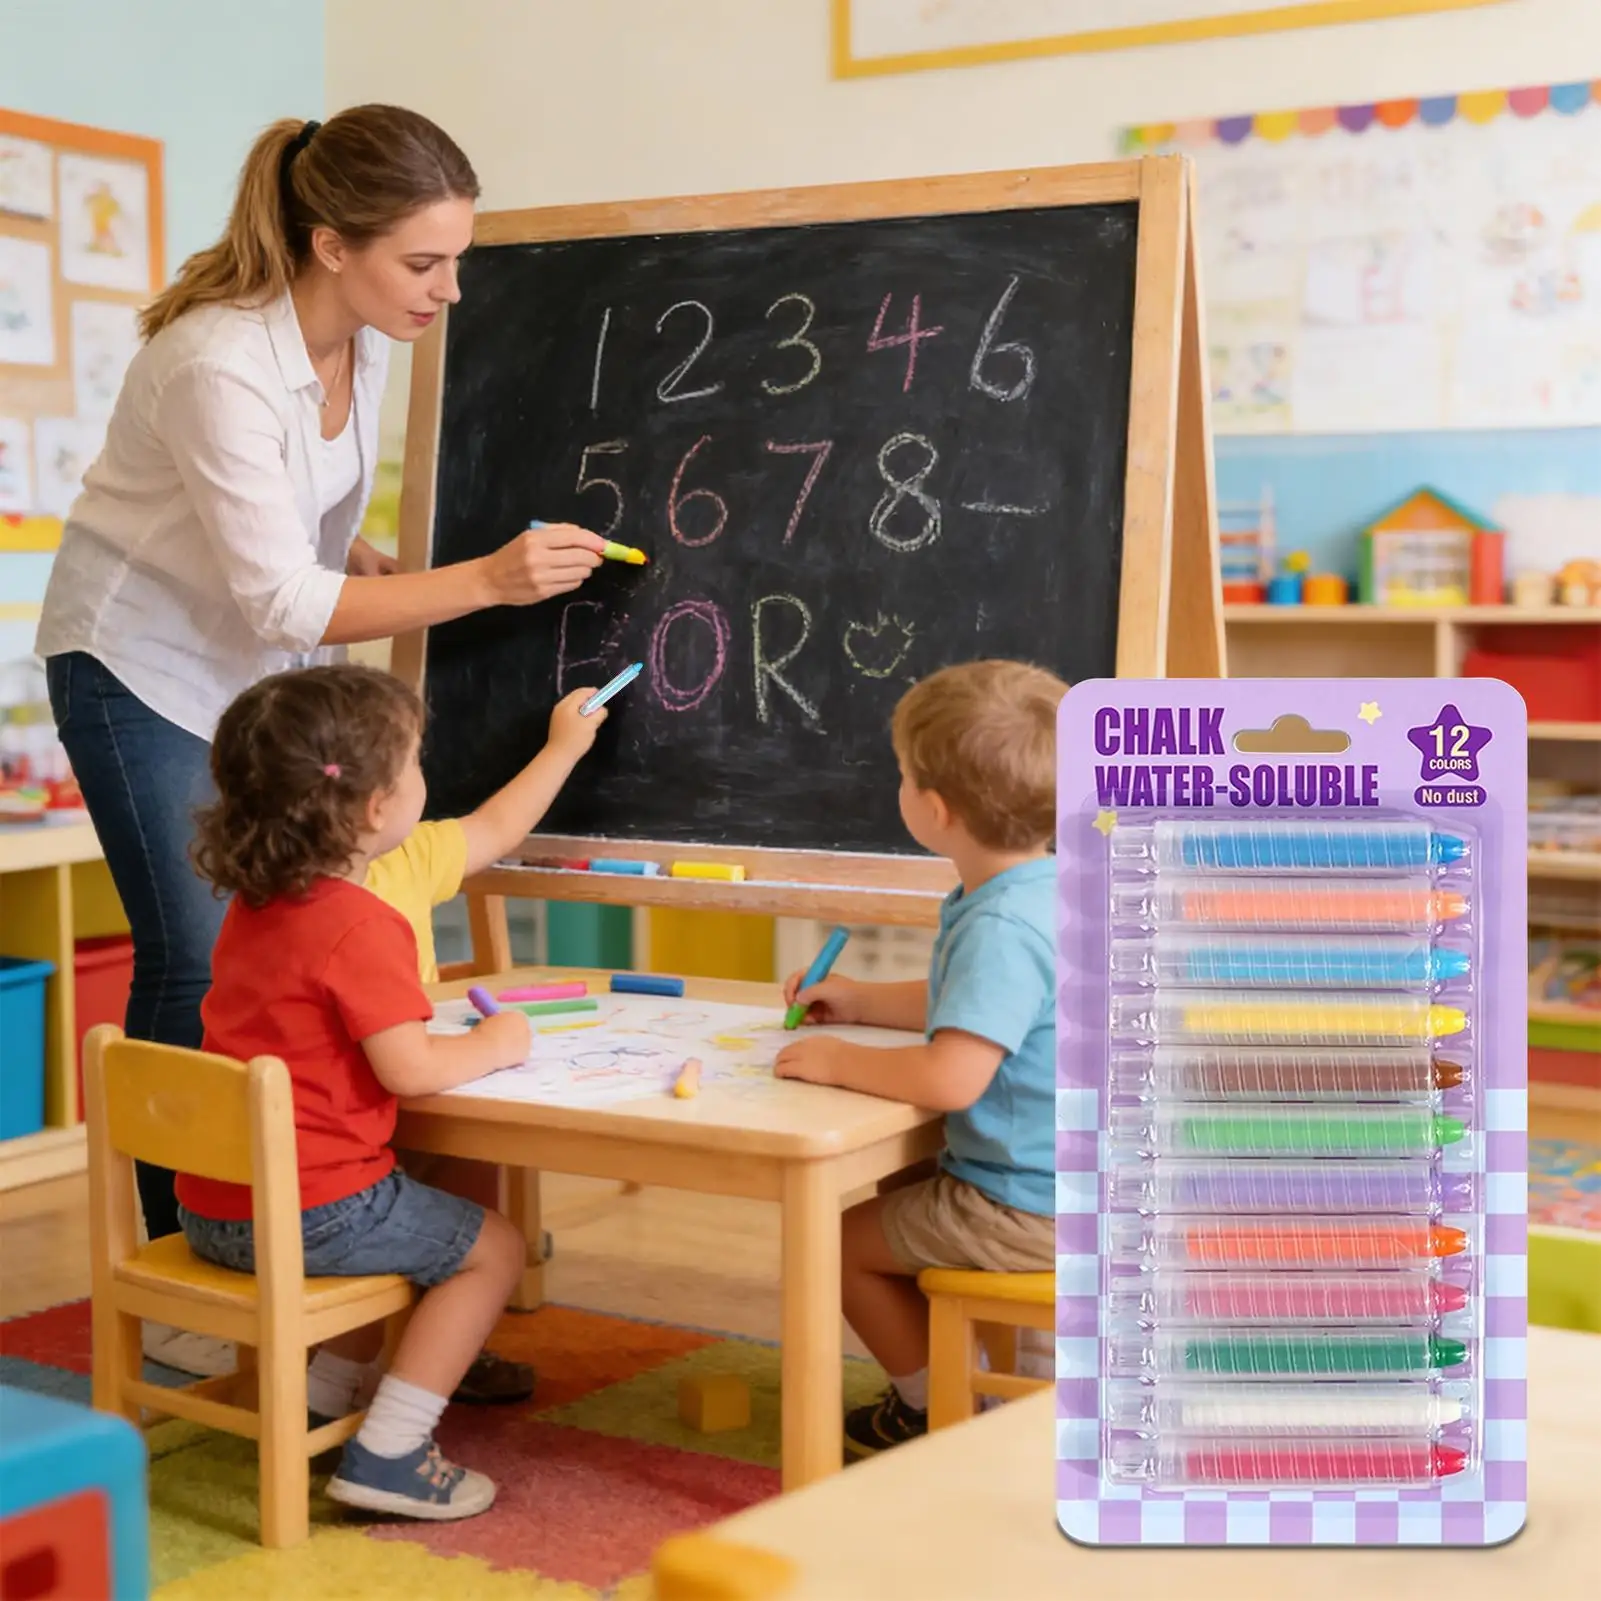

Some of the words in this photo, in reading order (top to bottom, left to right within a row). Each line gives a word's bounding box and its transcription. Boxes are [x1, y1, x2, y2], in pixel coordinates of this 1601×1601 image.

[590, 306, 611, 410] 1
[655, 300, 724, 403] 2
[760, 293, 822, 395] 3
[866, 293, 944, 392] 4
[969, 274, 1036, 402] 6
[575, 439, 628, 536] 5
[668, 434, 728, 547] 6
[765, 439, 833, 545] 7
[869, 431, 941, 552] 8
[1093, 706, 1225, 756] CHALK
[1428, 724, 1470, 757] 12
[1094, 764, 1379, 807] WATER-SOLUBLE
[1429, 758, 1472, 770] COLORS
[1422, 788, 1442, 804] No
[1446, 788, 1479, 804] dust
